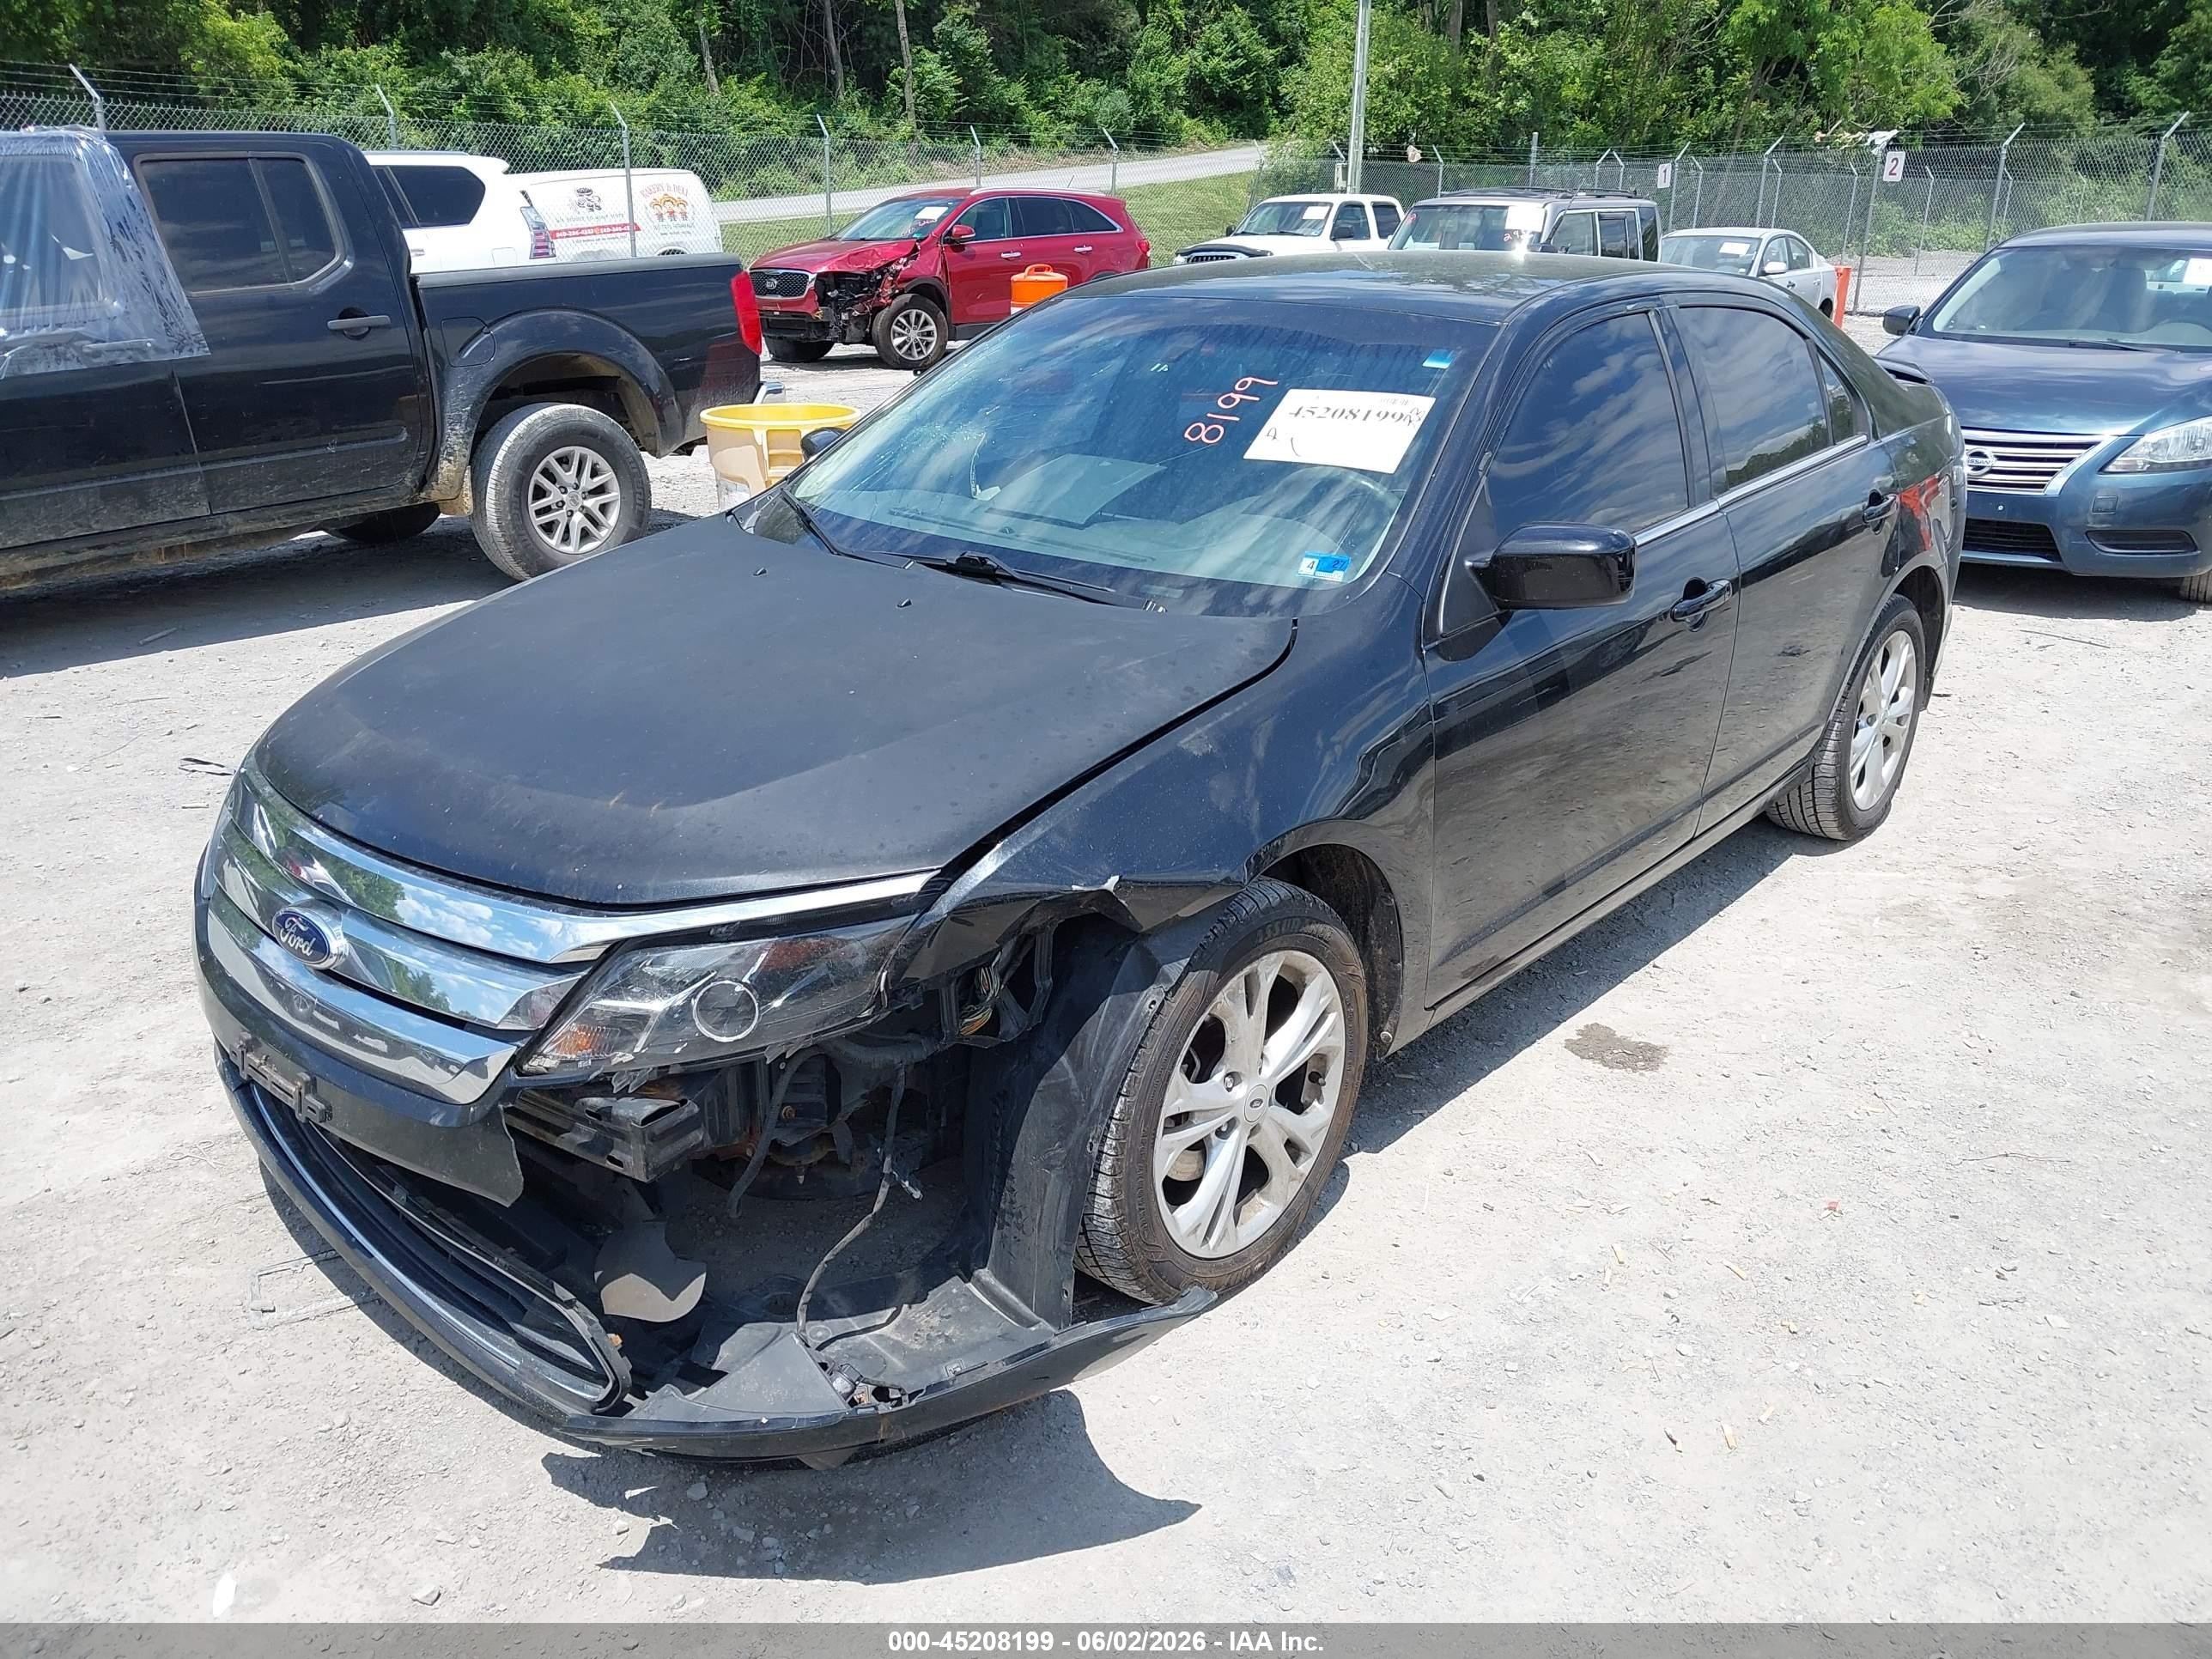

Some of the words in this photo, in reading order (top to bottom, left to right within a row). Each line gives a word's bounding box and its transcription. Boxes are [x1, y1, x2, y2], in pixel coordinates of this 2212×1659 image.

[1662, 168, 1667, 183] 1
[1889, 157, 1899, 176] 2
[1183, 376, 1279, 444] 8199
[1289, 405, 1406, 423] 45208199
[1306, 560, 1315, 570] 4
[1332, 560, 1346, 570] 27
[280, 916, 317, 957] Ford
